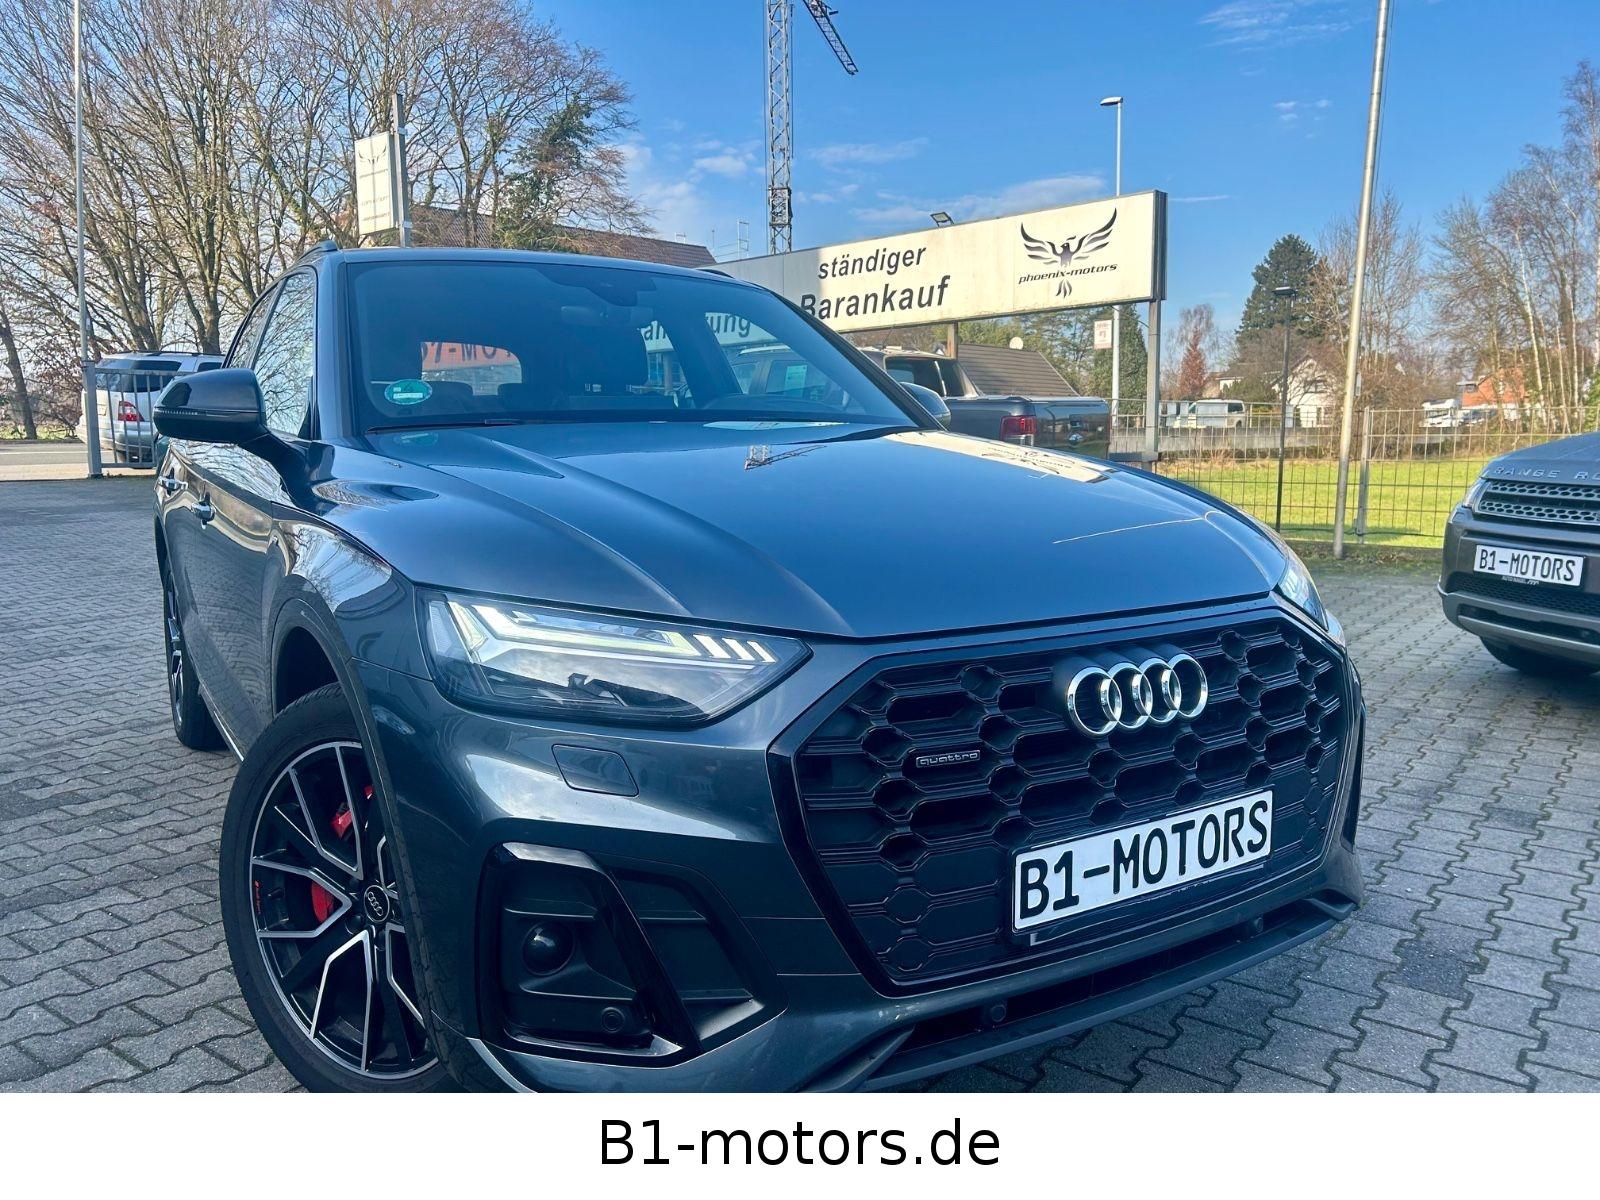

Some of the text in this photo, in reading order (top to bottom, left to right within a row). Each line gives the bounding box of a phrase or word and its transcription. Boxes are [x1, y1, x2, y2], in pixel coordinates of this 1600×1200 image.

[818, 247, 927, 280] ständiger
[1018, 263, 1118, 285] phoenix-motors
[800, 275, 951, 320] Barankauf
[1479, 548, 1576, 583] B1-MOTORS
[920, 752, 978, 766] quattro
[1019, 799, 1269, 920] B1-MOTORS
